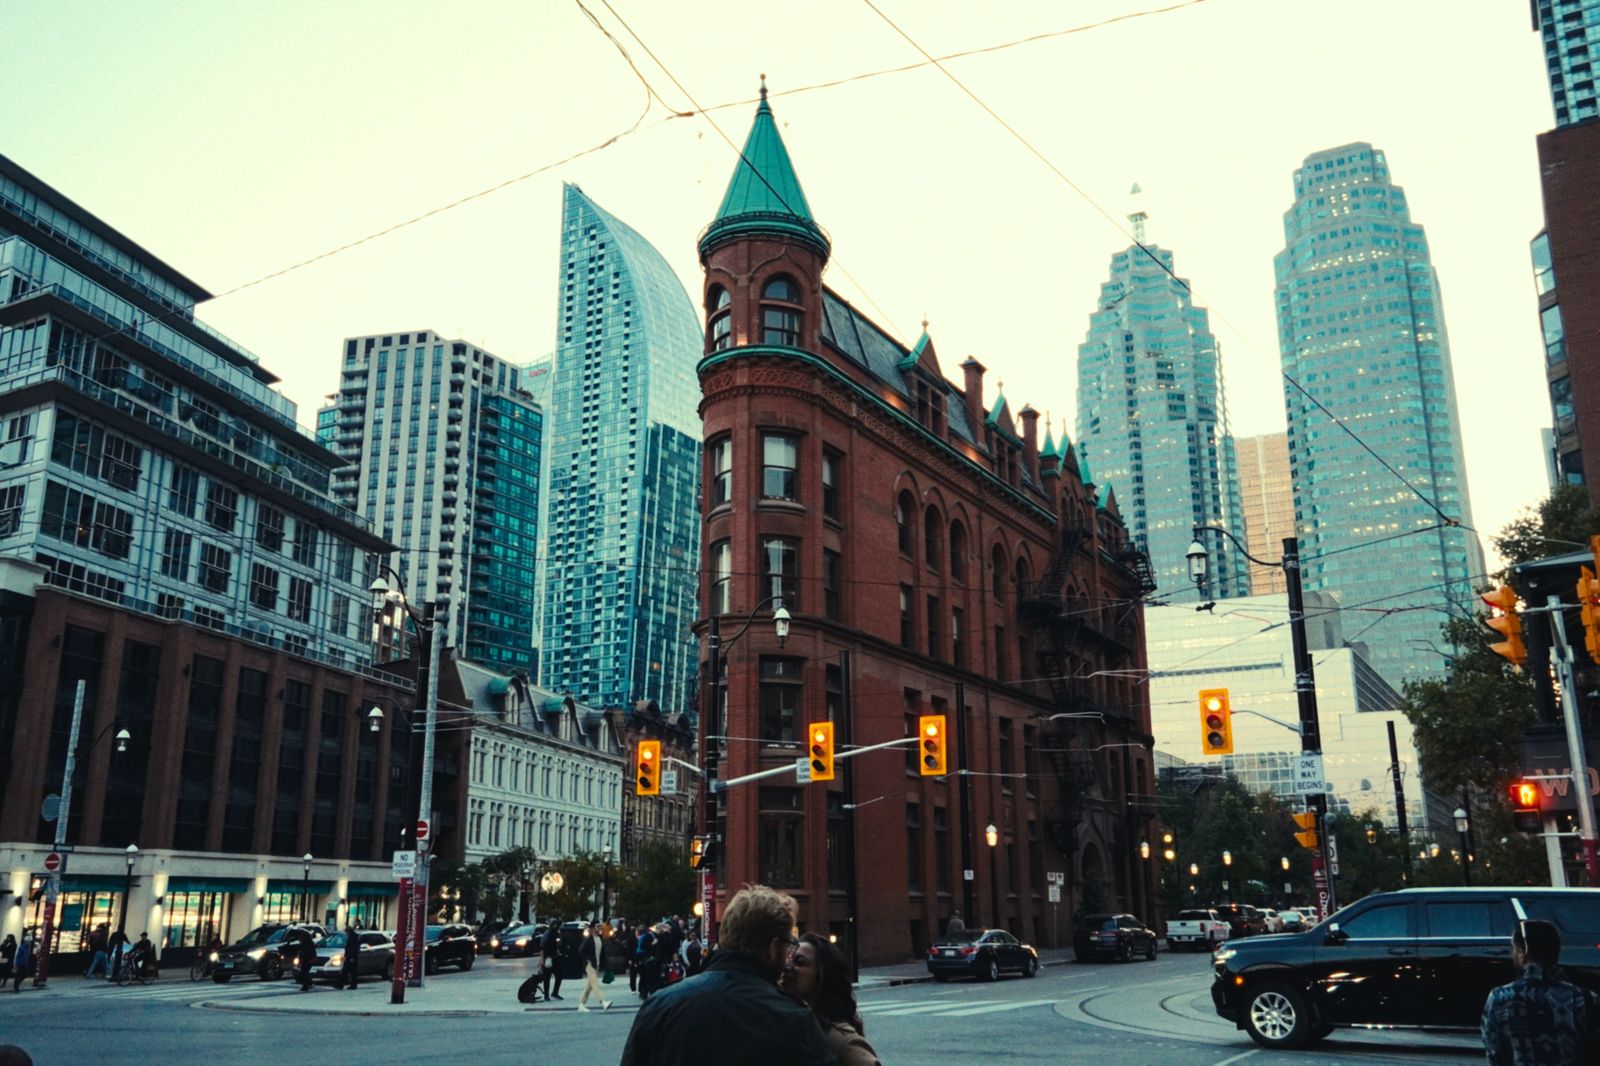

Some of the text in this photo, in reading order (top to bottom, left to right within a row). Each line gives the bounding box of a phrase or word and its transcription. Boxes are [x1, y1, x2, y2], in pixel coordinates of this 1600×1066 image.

[1300, 760, 1315, 769] ONE
[1301, 771, 1316, 779] WAY
[1297, 781, 1323, 790] BEGINS
[400, 854, 409, 862] NO
